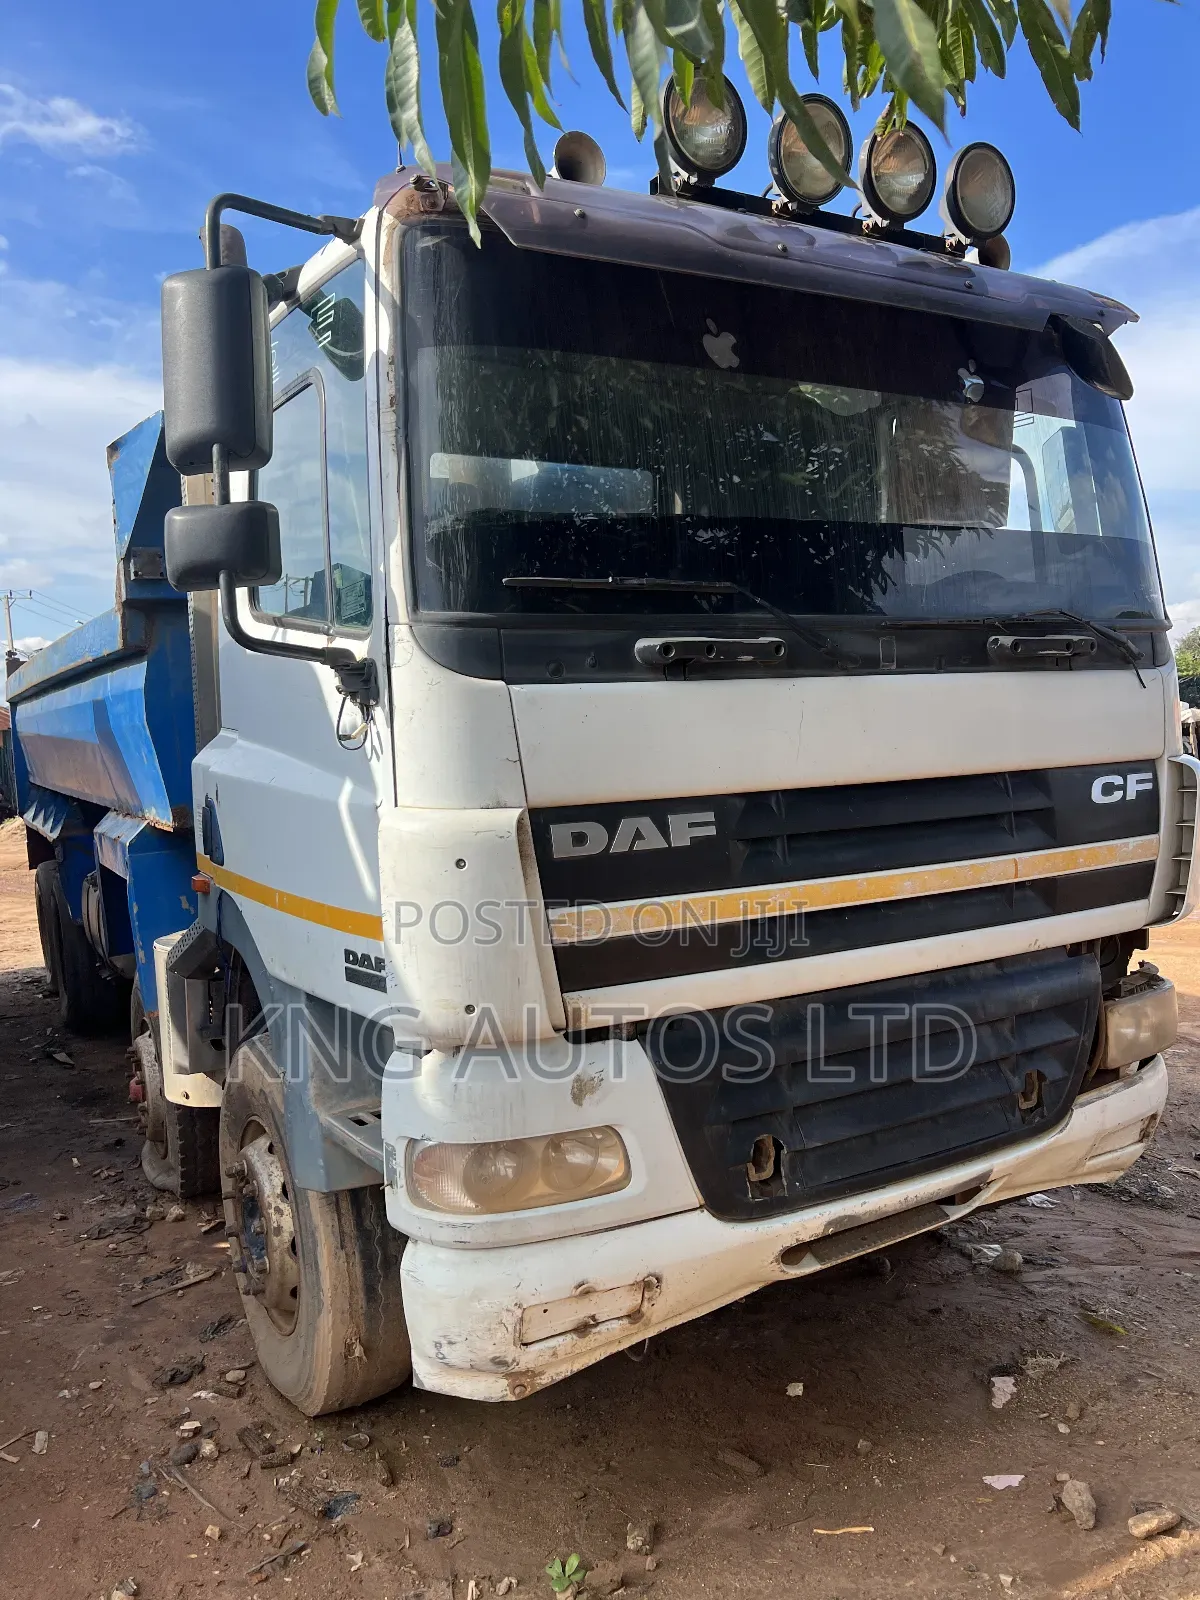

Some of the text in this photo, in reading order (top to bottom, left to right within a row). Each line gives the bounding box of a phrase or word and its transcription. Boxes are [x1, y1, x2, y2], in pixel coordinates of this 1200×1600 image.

[1091, 772, 1153, 804] CF
[550, 812, 717, 858] DAF
[344, 948, 386, 973] DAF
